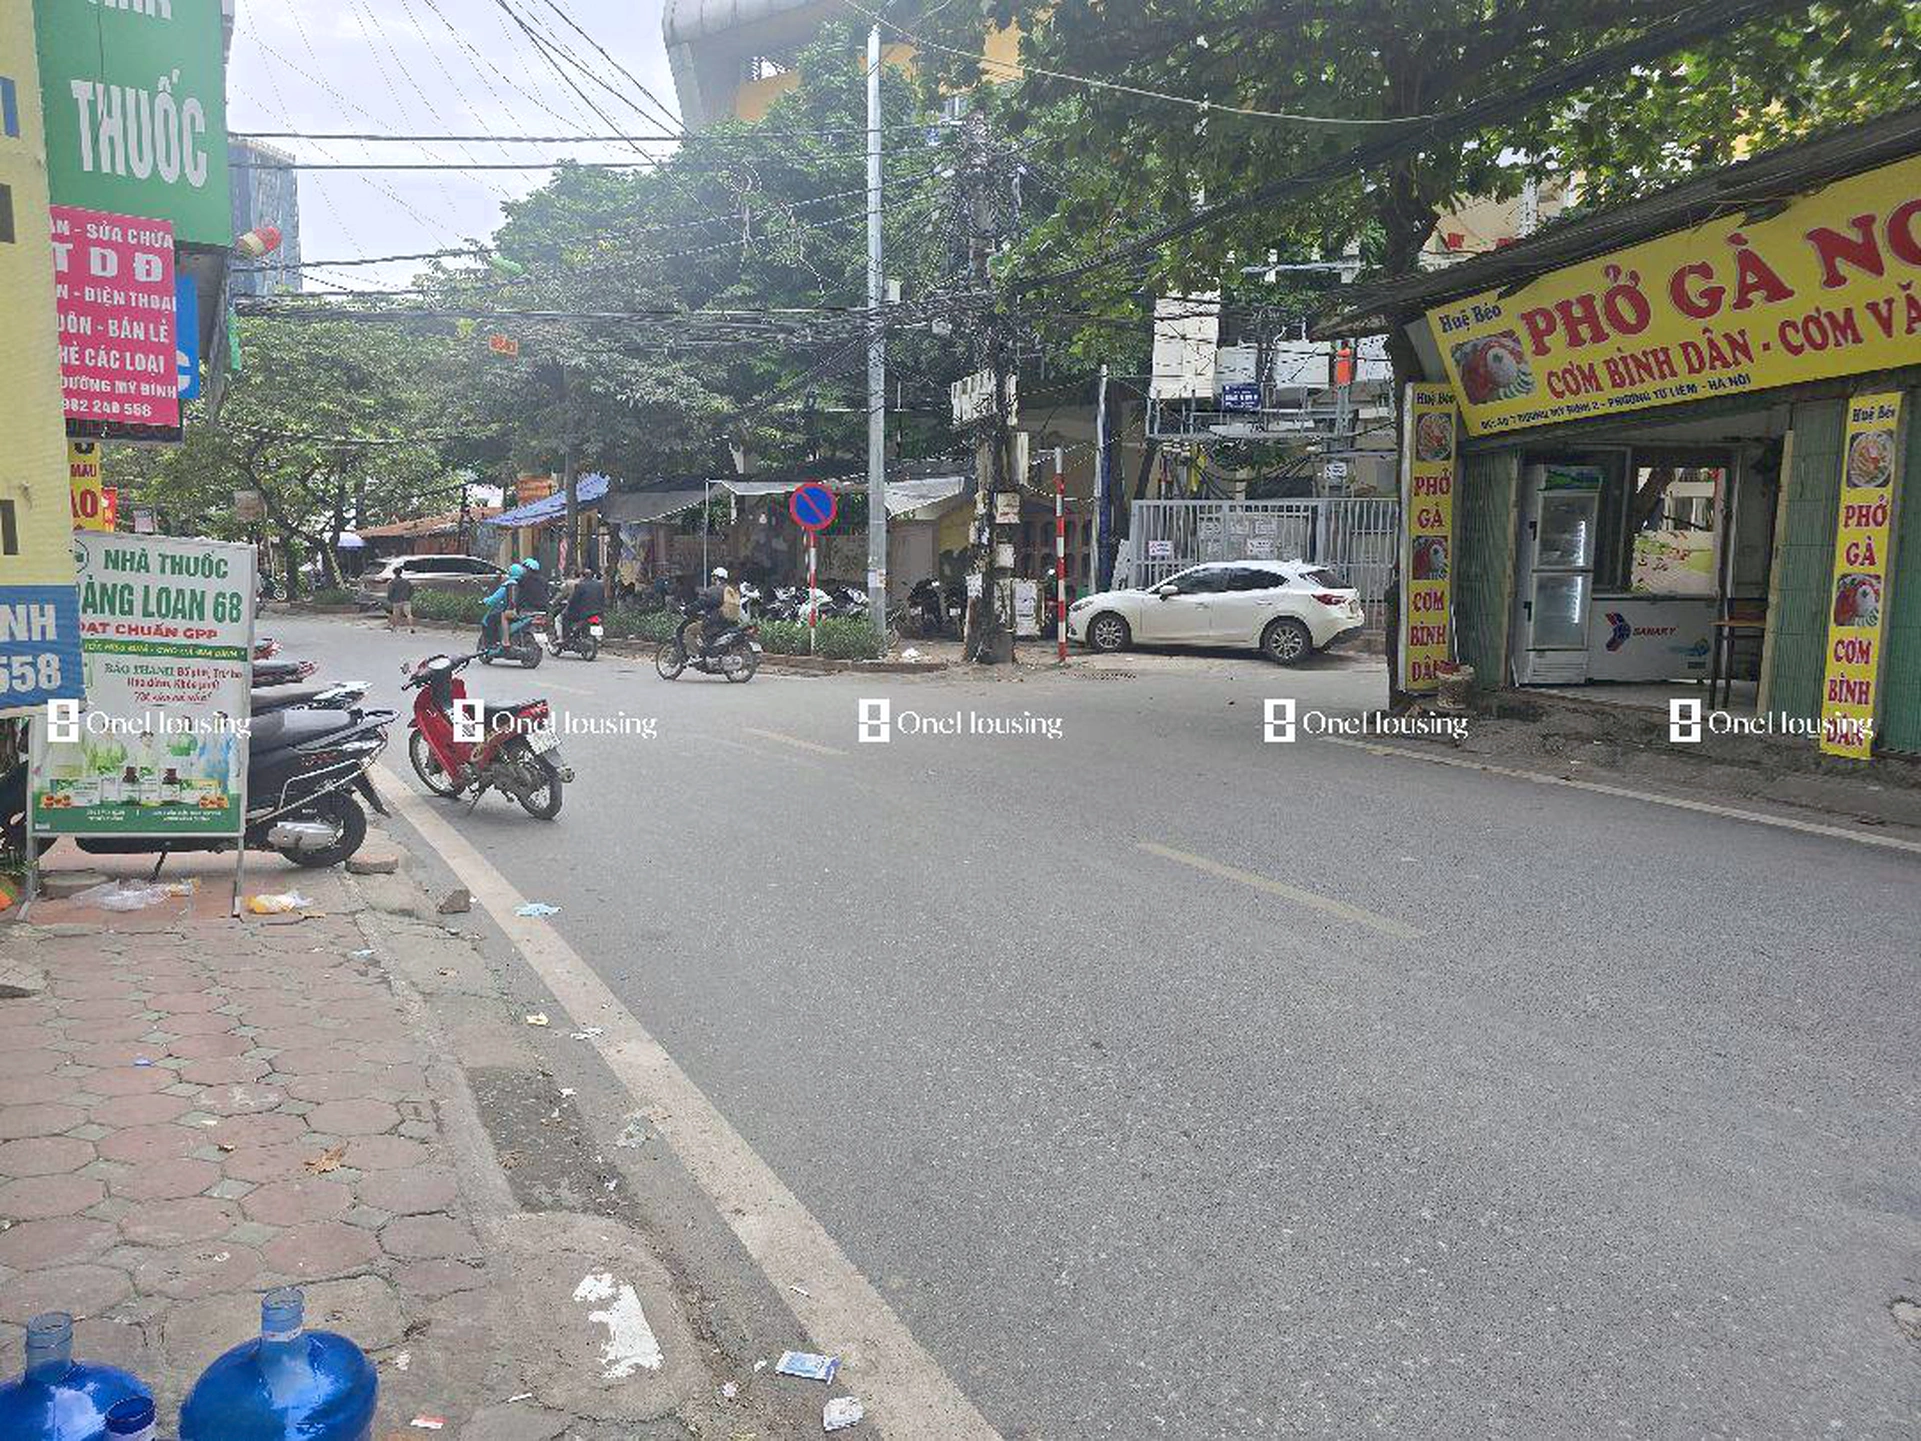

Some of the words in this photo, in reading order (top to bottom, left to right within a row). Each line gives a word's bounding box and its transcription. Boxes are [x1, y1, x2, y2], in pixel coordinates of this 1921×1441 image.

[70, 69, 207, 187] THUỐC
[1519, 264, 1650, 356] PHỞ
[1669, 231, 1795, 319] GÀ
[108, 316, 145, 341] BÁN
[1438, 308, 1470, 332] Huệ
[1471, 302, 1502, 323] Béo
[85, 345, 120, 370] CÁC
[125, 352, 165, 377] LOẠI
[1546, 361, 1604, 399] CƠM
[1602, 347, 1678, 388] BÌNH
[1679, 327, 1755, 374] DÂN
[1778, 306, 1863, 356] CƠM
[1414, 466, 1452, 497] PHỞ
[1417, 501, 1446, 530] GÀ
[1843, 494, 1888, 528] PHỞ
[103, 548, 151, 574] NHÀ
[157, 550, 229, 579] THUỐC
[1845, 535, 1877, 566] GÀ
[76, 575, 134, 616] ẢNG
[141, 584, 206, 622] LOAN
[213, 591, 243, 623] 68
[1413, 590, 1445, 613] CƠM
[115, 622, 178, 637] CHUẨN
[183, 627, 218, 640] GPP
[1410, 620, 1447, 647] BÌNH
[1834, 636, 1872, 665] CƠM
[1828, 671, 1871, 705] BÌNH
